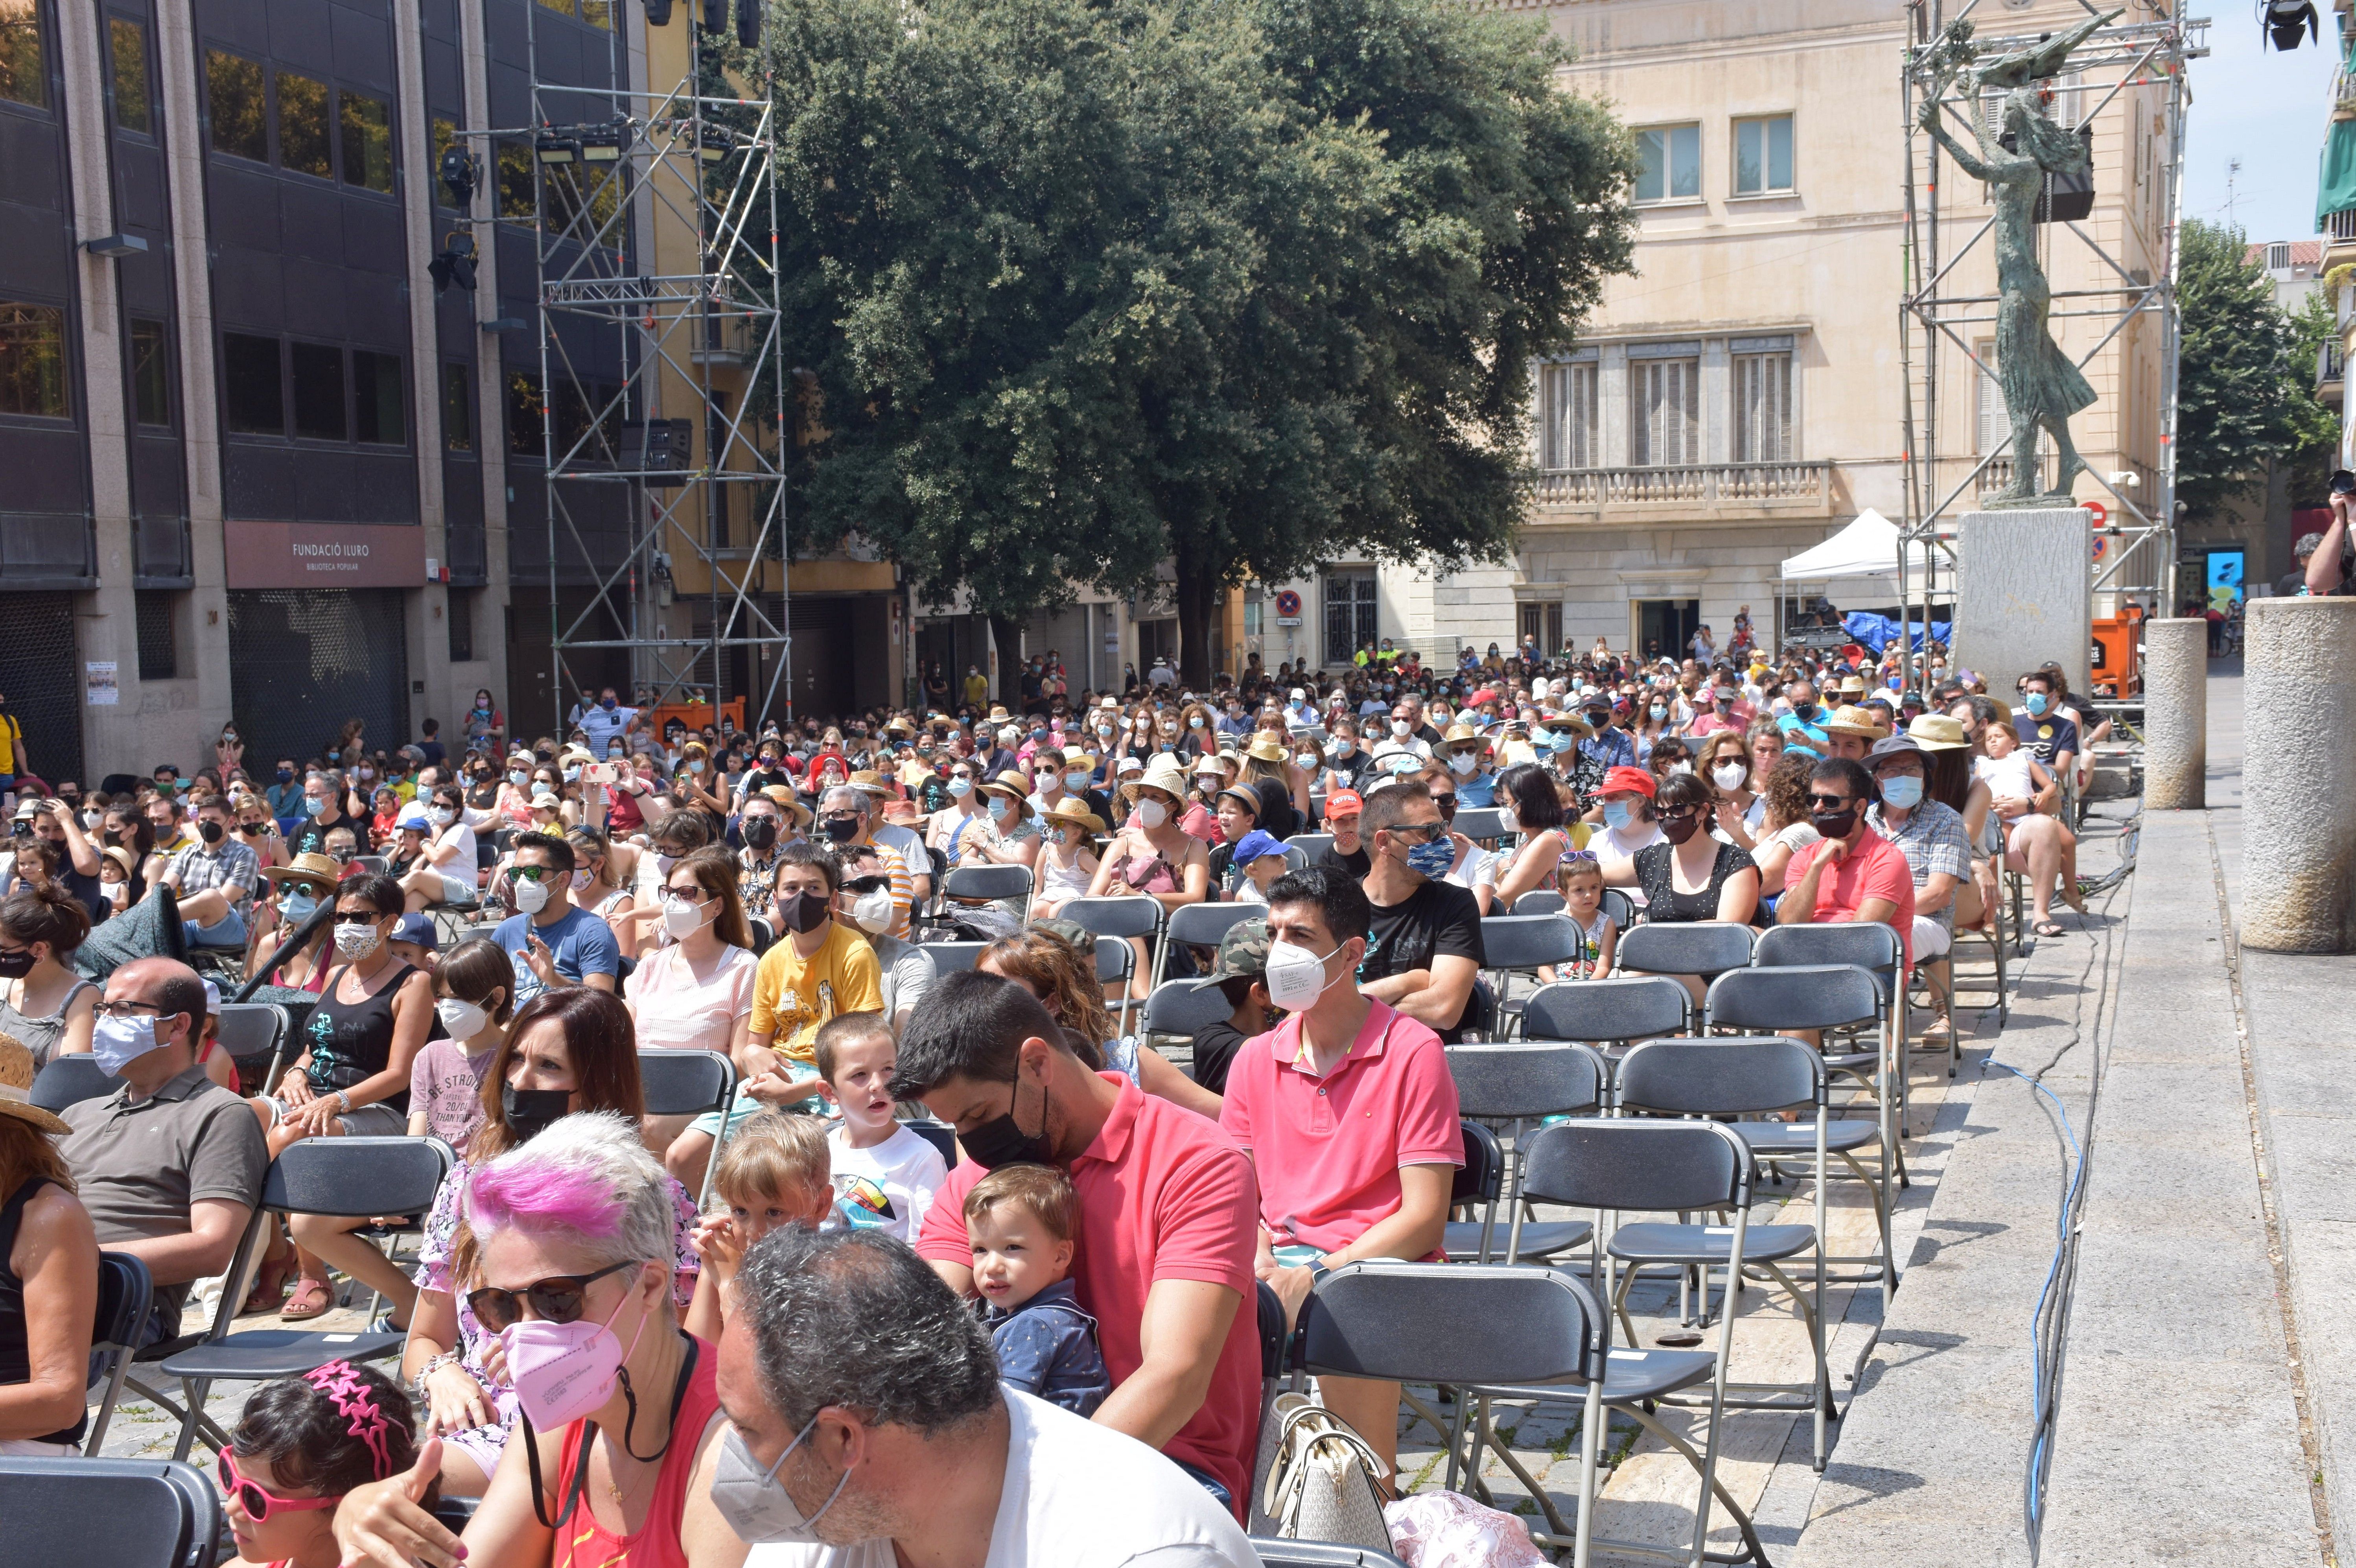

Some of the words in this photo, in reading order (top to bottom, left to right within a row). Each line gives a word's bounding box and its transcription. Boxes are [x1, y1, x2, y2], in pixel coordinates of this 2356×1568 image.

[293, 542, 341, 556] FUNDACIÓ
[344, 545, 369, 556] ILURO
[428, 1083, 444, 1100] BE
[436, 1113, 455, 1122] THAN
[457, 1113, 473, 1123] YOUR
